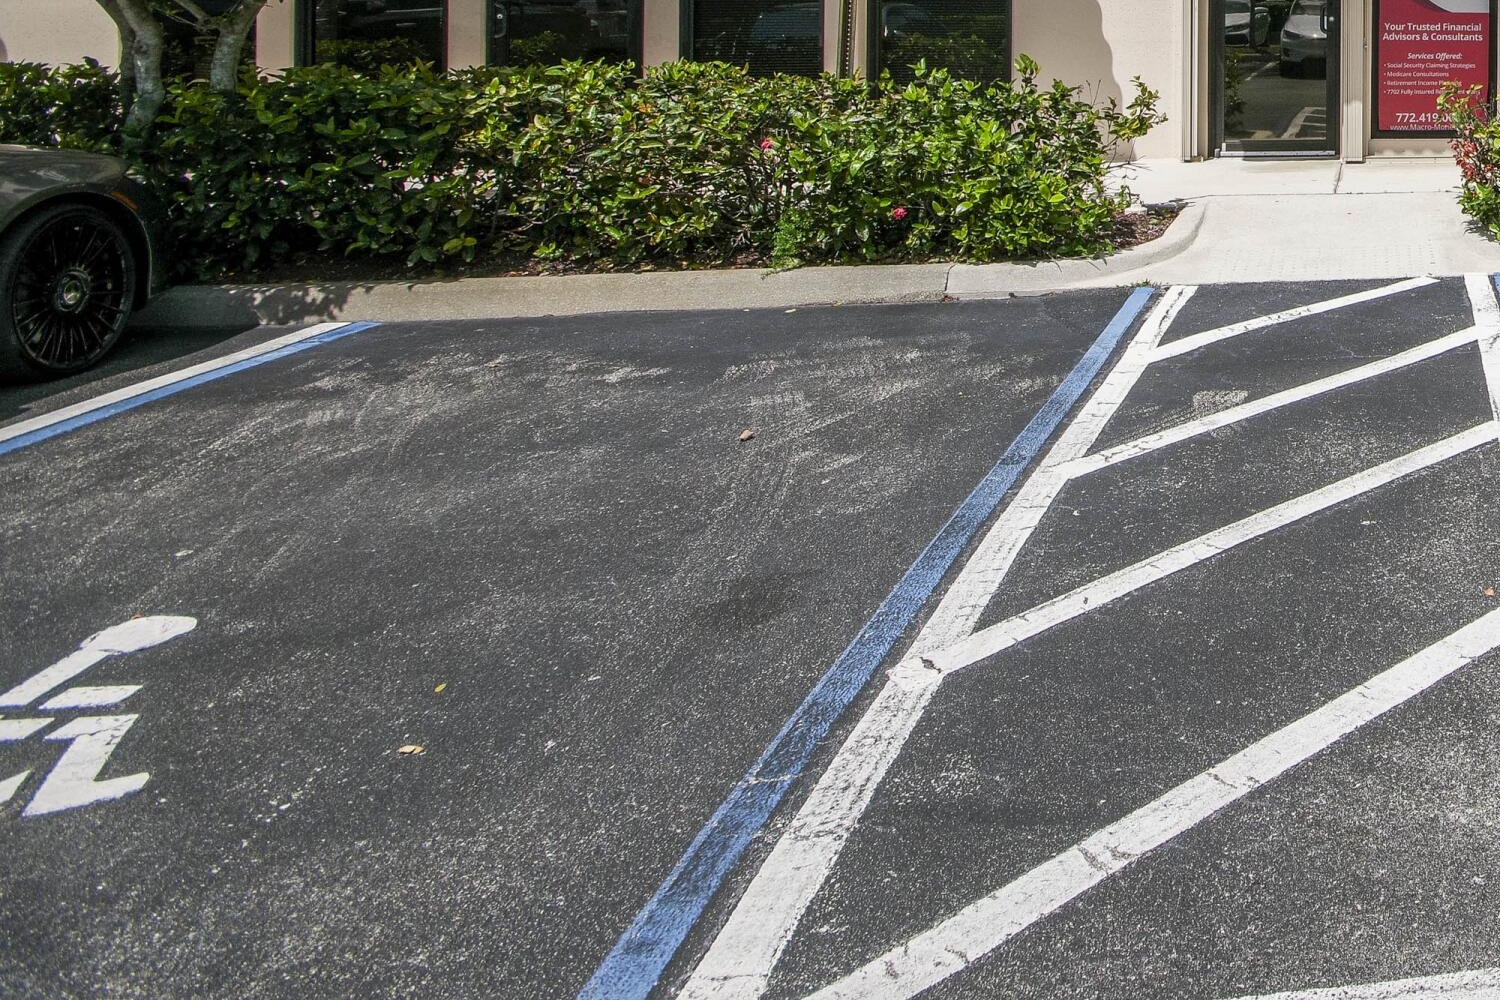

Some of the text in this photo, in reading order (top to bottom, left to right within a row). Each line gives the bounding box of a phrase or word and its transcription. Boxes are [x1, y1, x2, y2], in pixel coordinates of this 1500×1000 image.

[1384, 22, 1482, 31] Your Trusted Financial
[1383, 33, 1483, 41] Advisors & Consultants
[1407, 52, 1463, 61] Services Offered:
